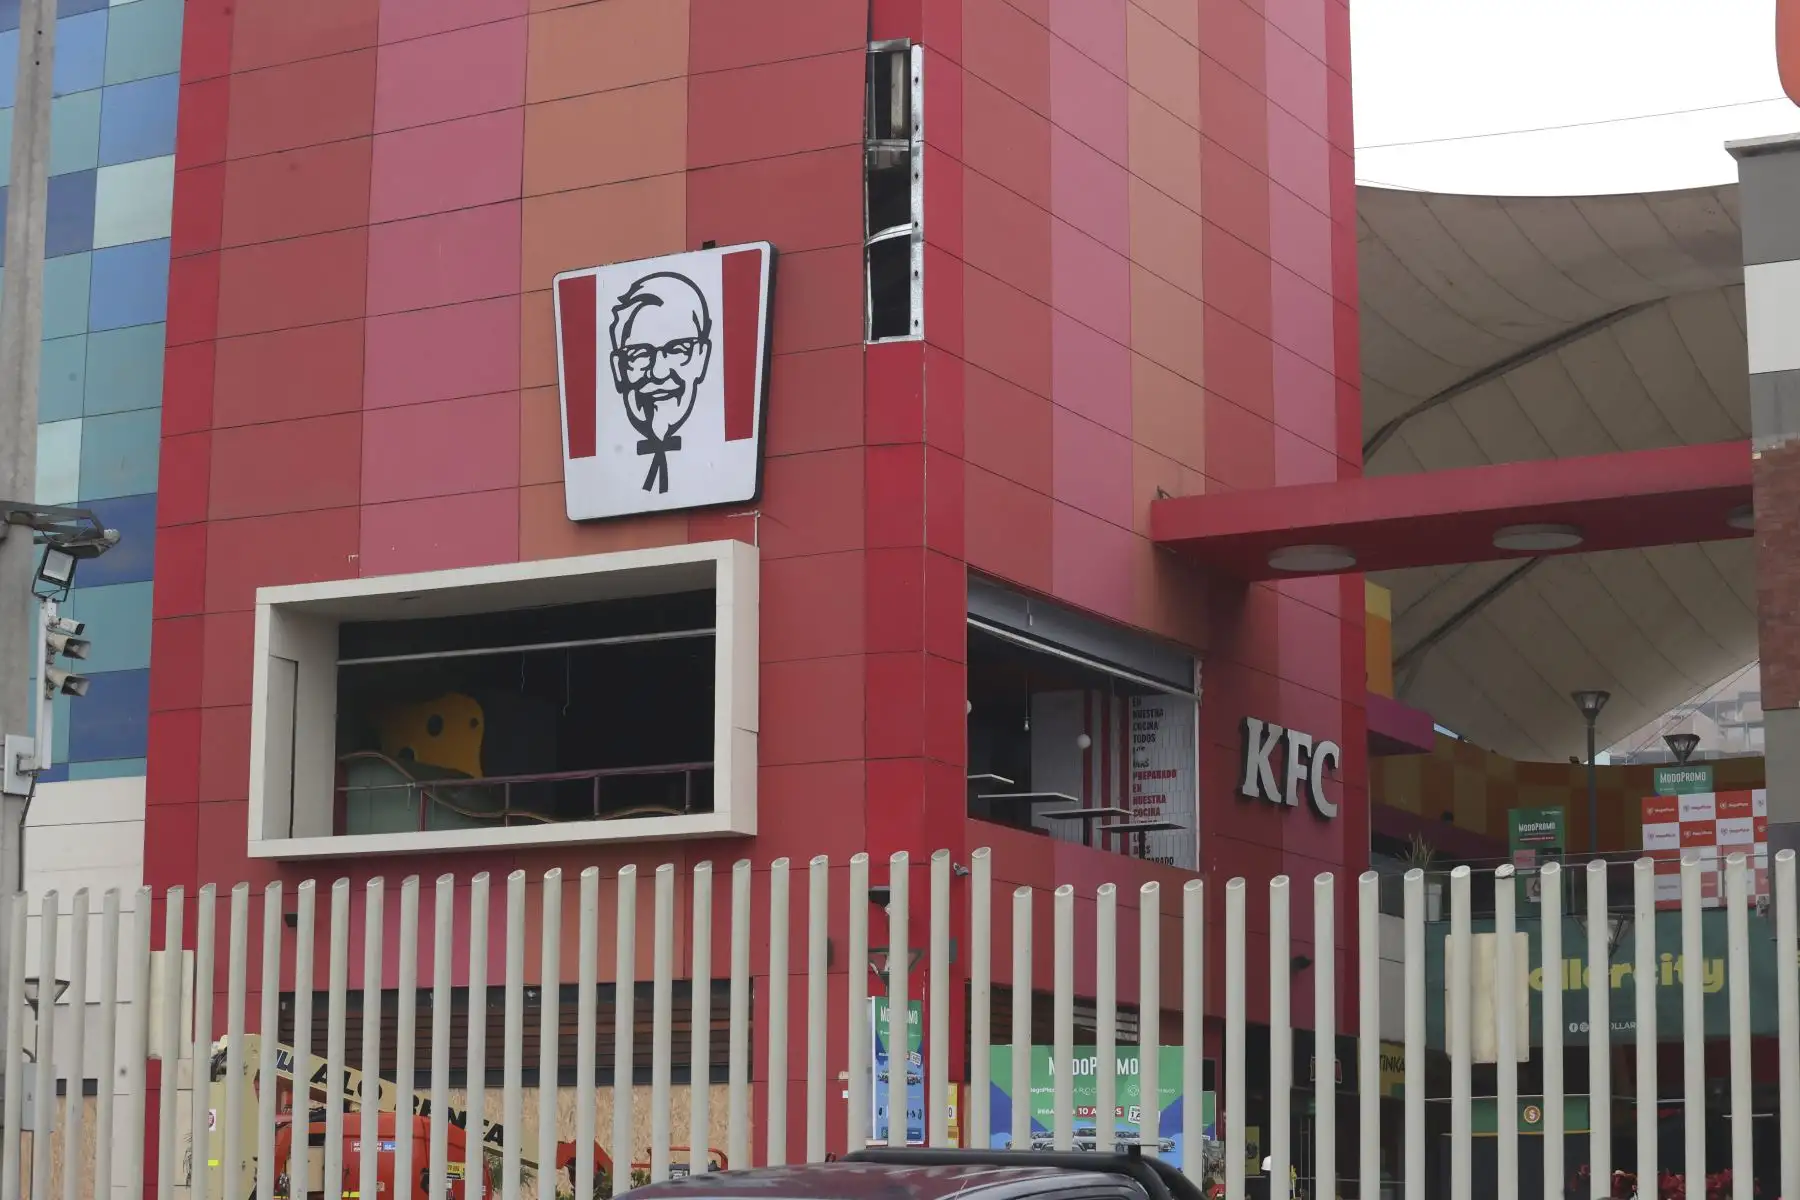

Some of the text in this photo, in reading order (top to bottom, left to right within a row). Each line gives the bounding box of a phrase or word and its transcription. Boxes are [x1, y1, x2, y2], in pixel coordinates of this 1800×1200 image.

[1242, 716, 1340, 818] KFC
[1660, 771, 1707, 783] MODOPROMO
[1132, 794, 1167, 805] NUESTRA
[1133, 807, 1161, 817] COCINA
